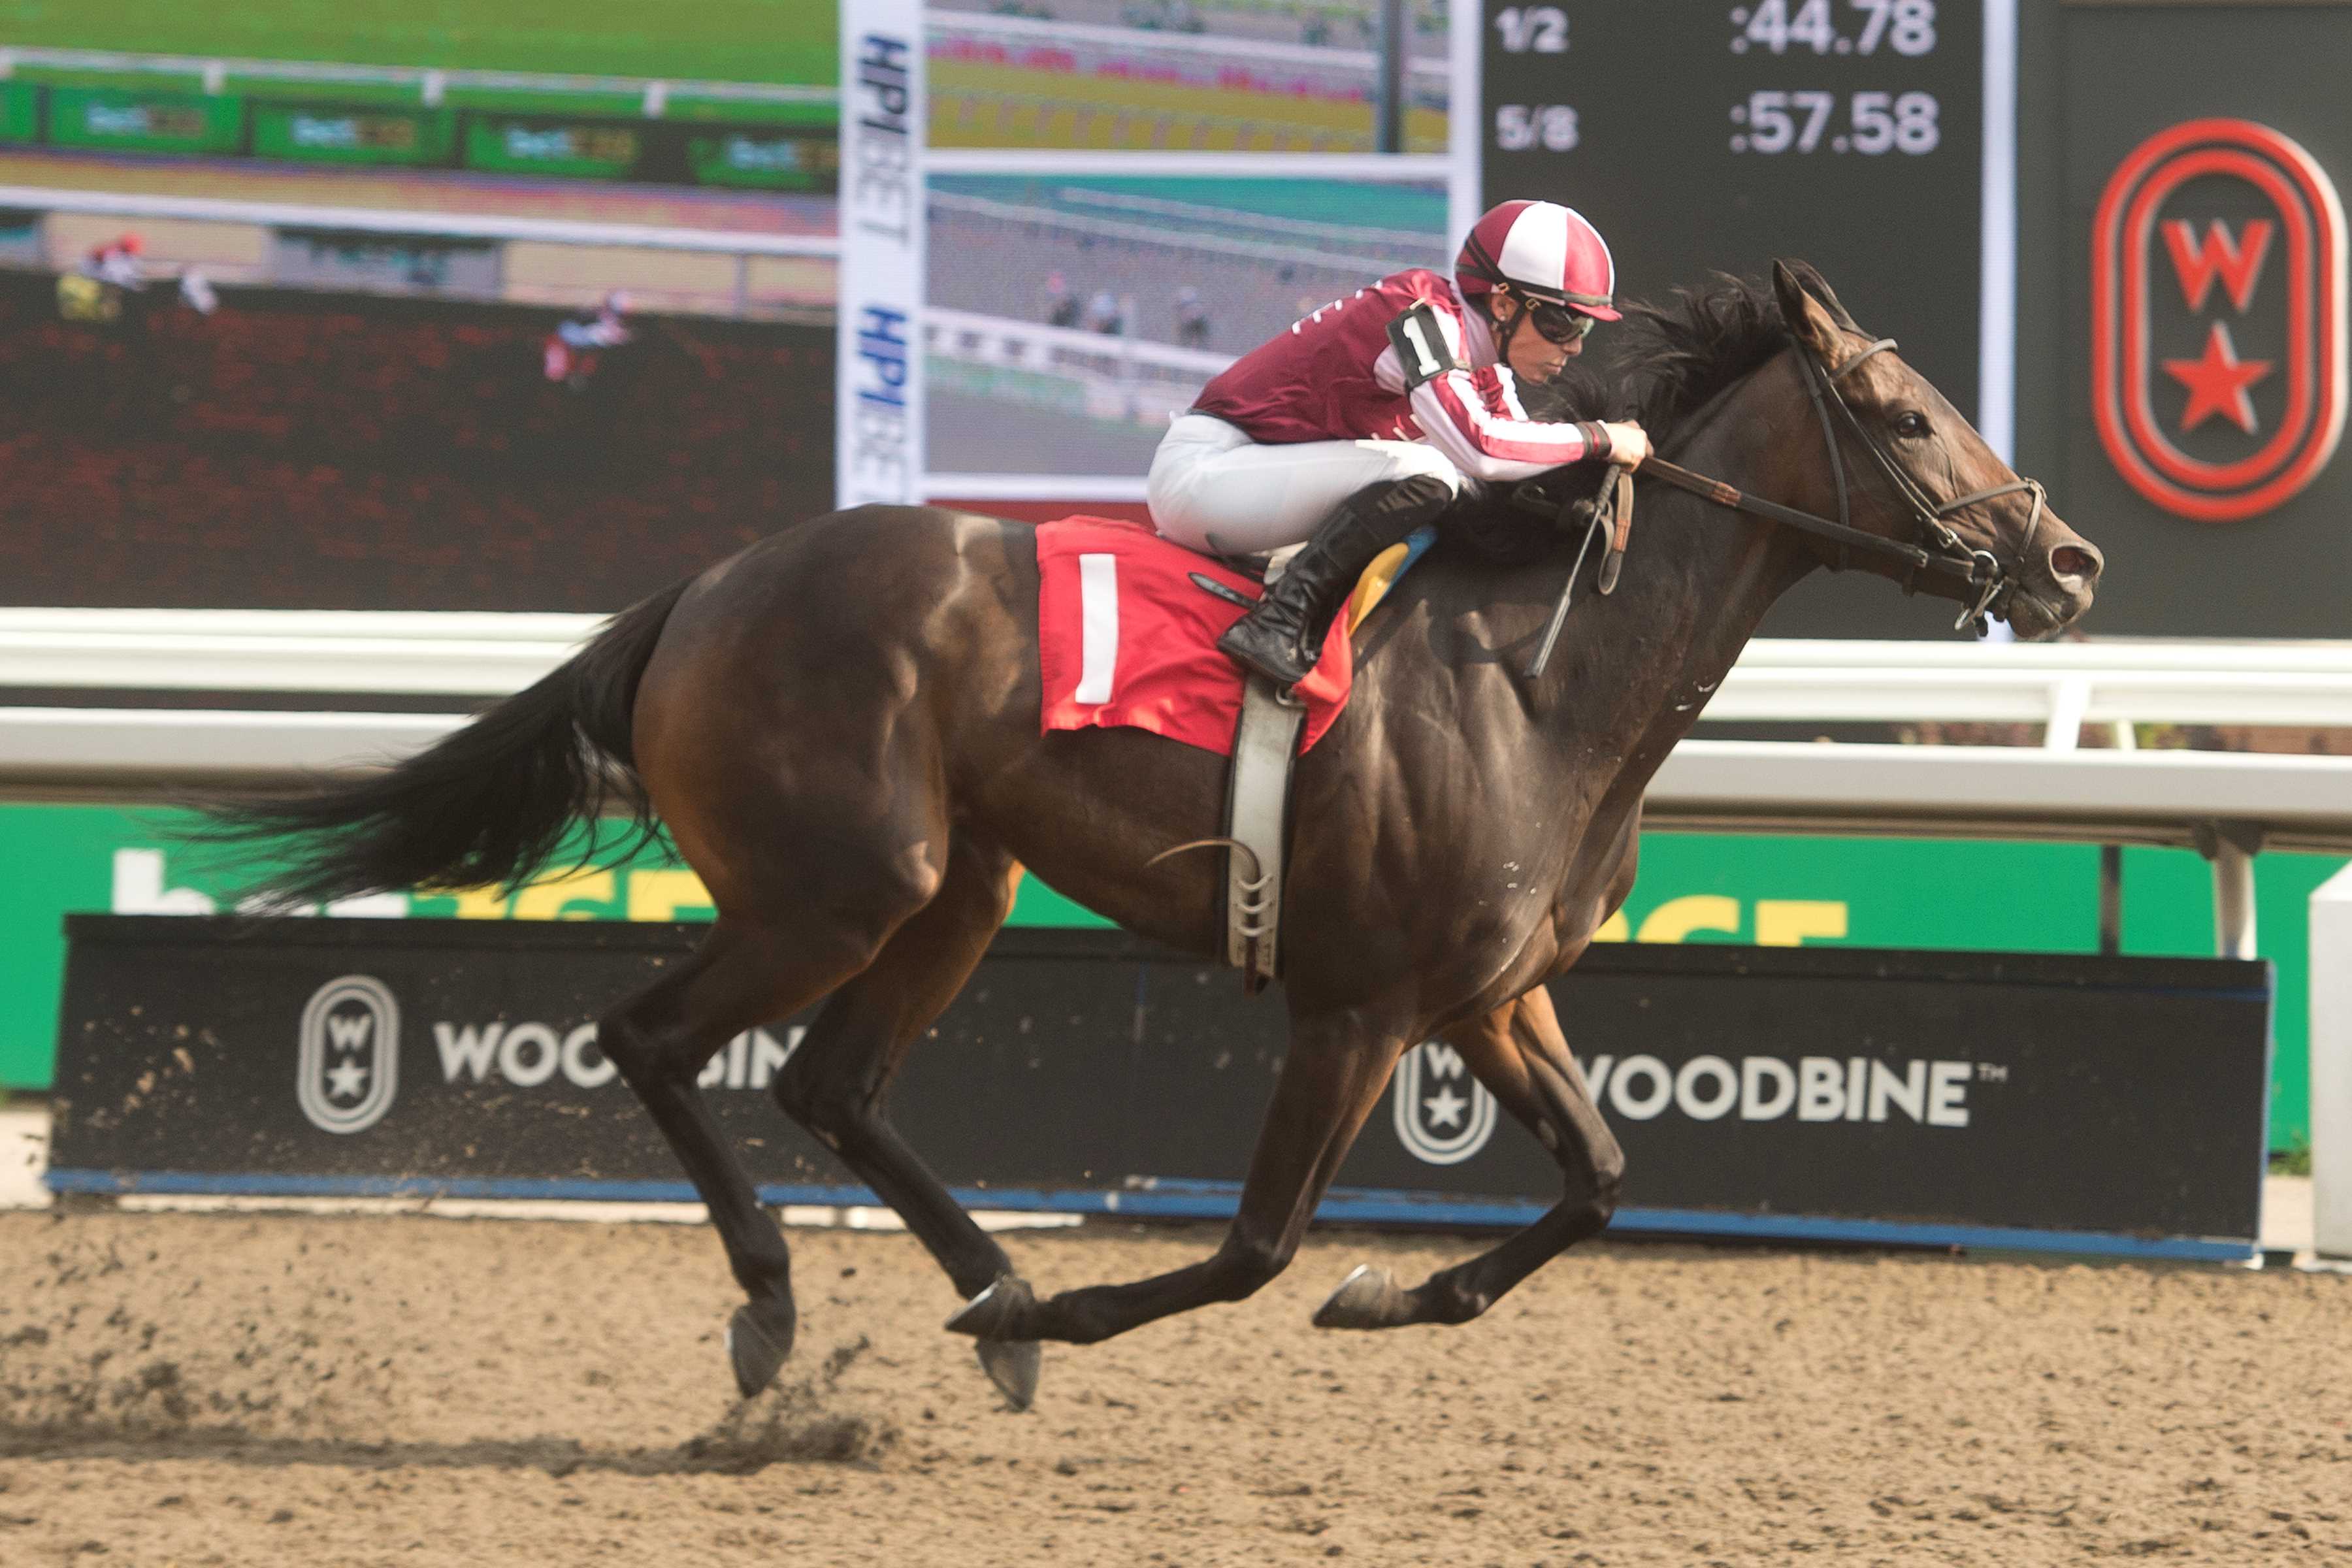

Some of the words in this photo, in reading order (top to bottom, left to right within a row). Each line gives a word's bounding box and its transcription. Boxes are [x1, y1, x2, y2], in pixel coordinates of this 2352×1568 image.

[1495, 7, 1569, 53] 1/2
[1729, 0, 1936, 56] :44.78
[1495, 104, 1579, 152] 5/8
[1729, 91, 1939, 154] :57.58
[2160, 218, 2272, 313] W
[1403, 316, 1441, 377] 1
[1075, 553, 1119, 705] 1
[432, 1021, 808, 1088] WOOIN
